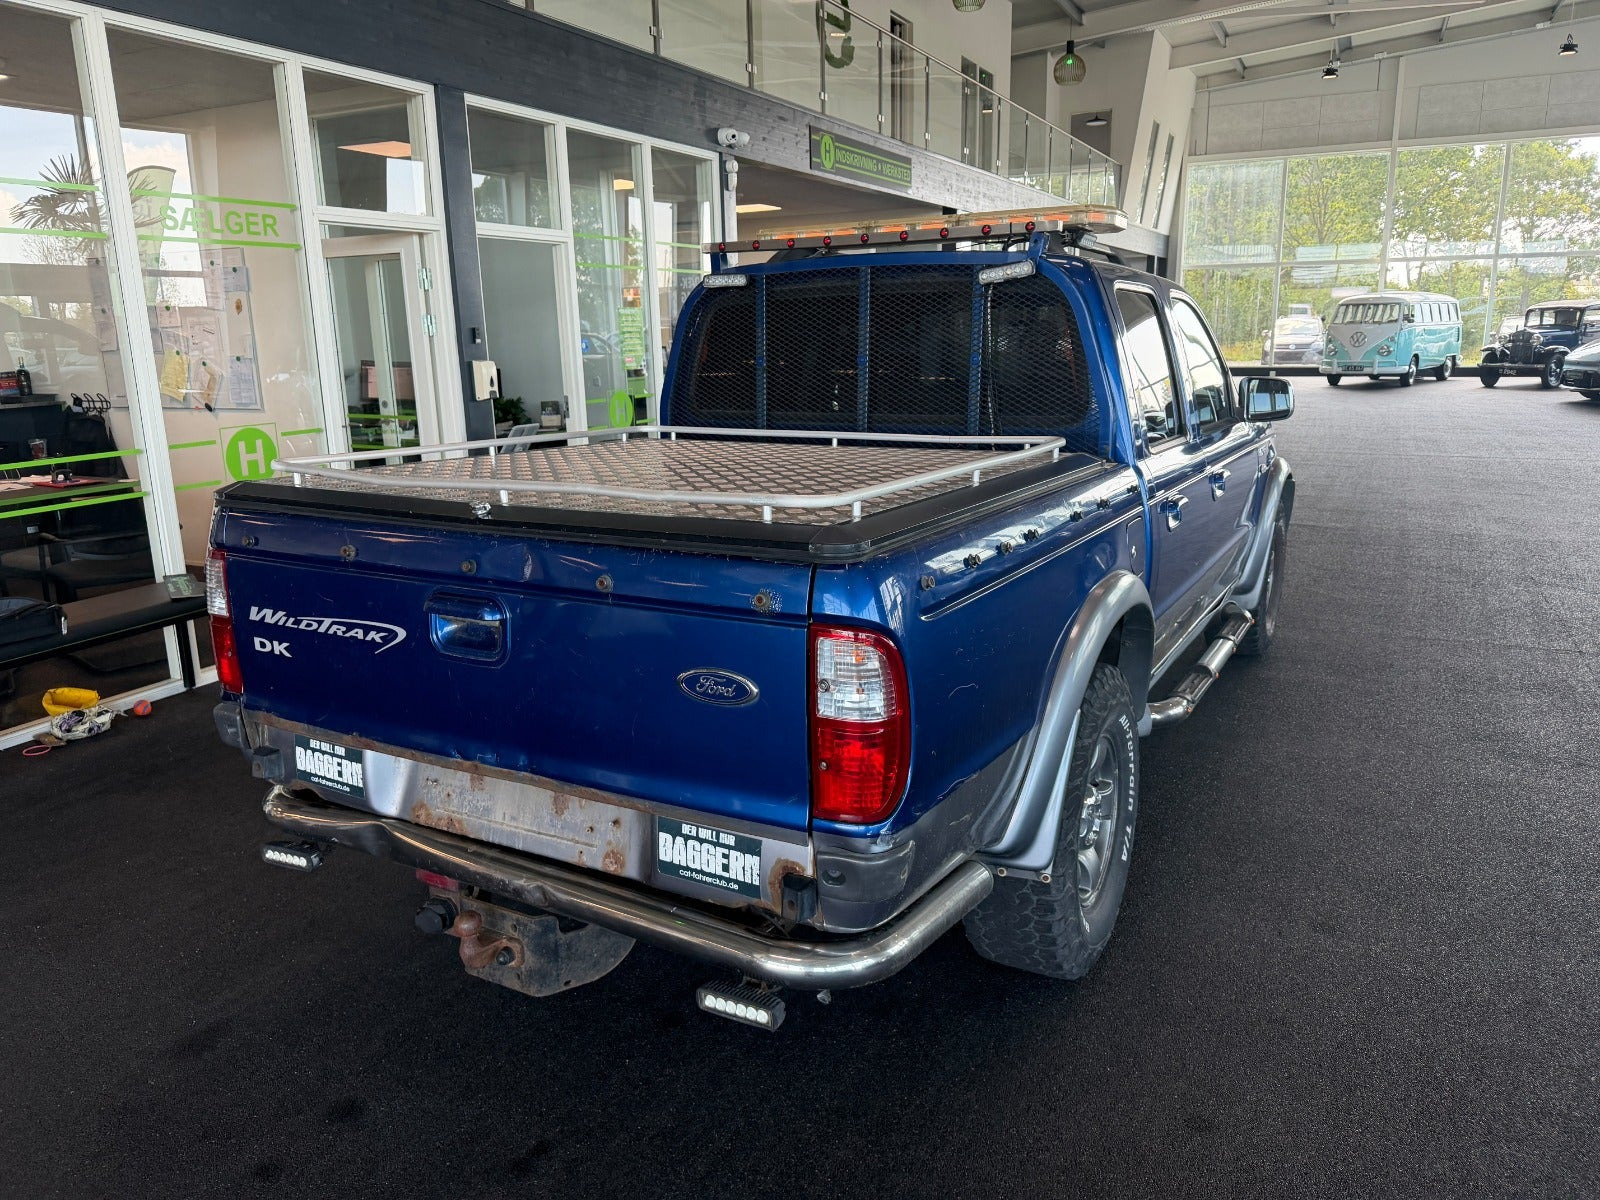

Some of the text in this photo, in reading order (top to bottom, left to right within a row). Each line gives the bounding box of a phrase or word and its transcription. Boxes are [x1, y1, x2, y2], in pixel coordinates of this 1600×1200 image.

[835, 148, 877, 171] INDSKRIVNING
[159, 205, 280, 238] SÆLGER
[238, 438, 266, 476] H
[253, 636, 293, 658] DK
[696, 675, 737, 697] Ford
[310, 738, 320, 749] DER
[321, 741, 334, 753] WILL
[295, 745, 364, 788] BAGGERN
[1118, 714, 1135, 861] All-Terrain T/A
[681, 823, 736, 847] DER WILL NUR
[658, 831, 760, 886] BAGGERN
[679, 869, 739, 890] cat-fahrerclub.de
